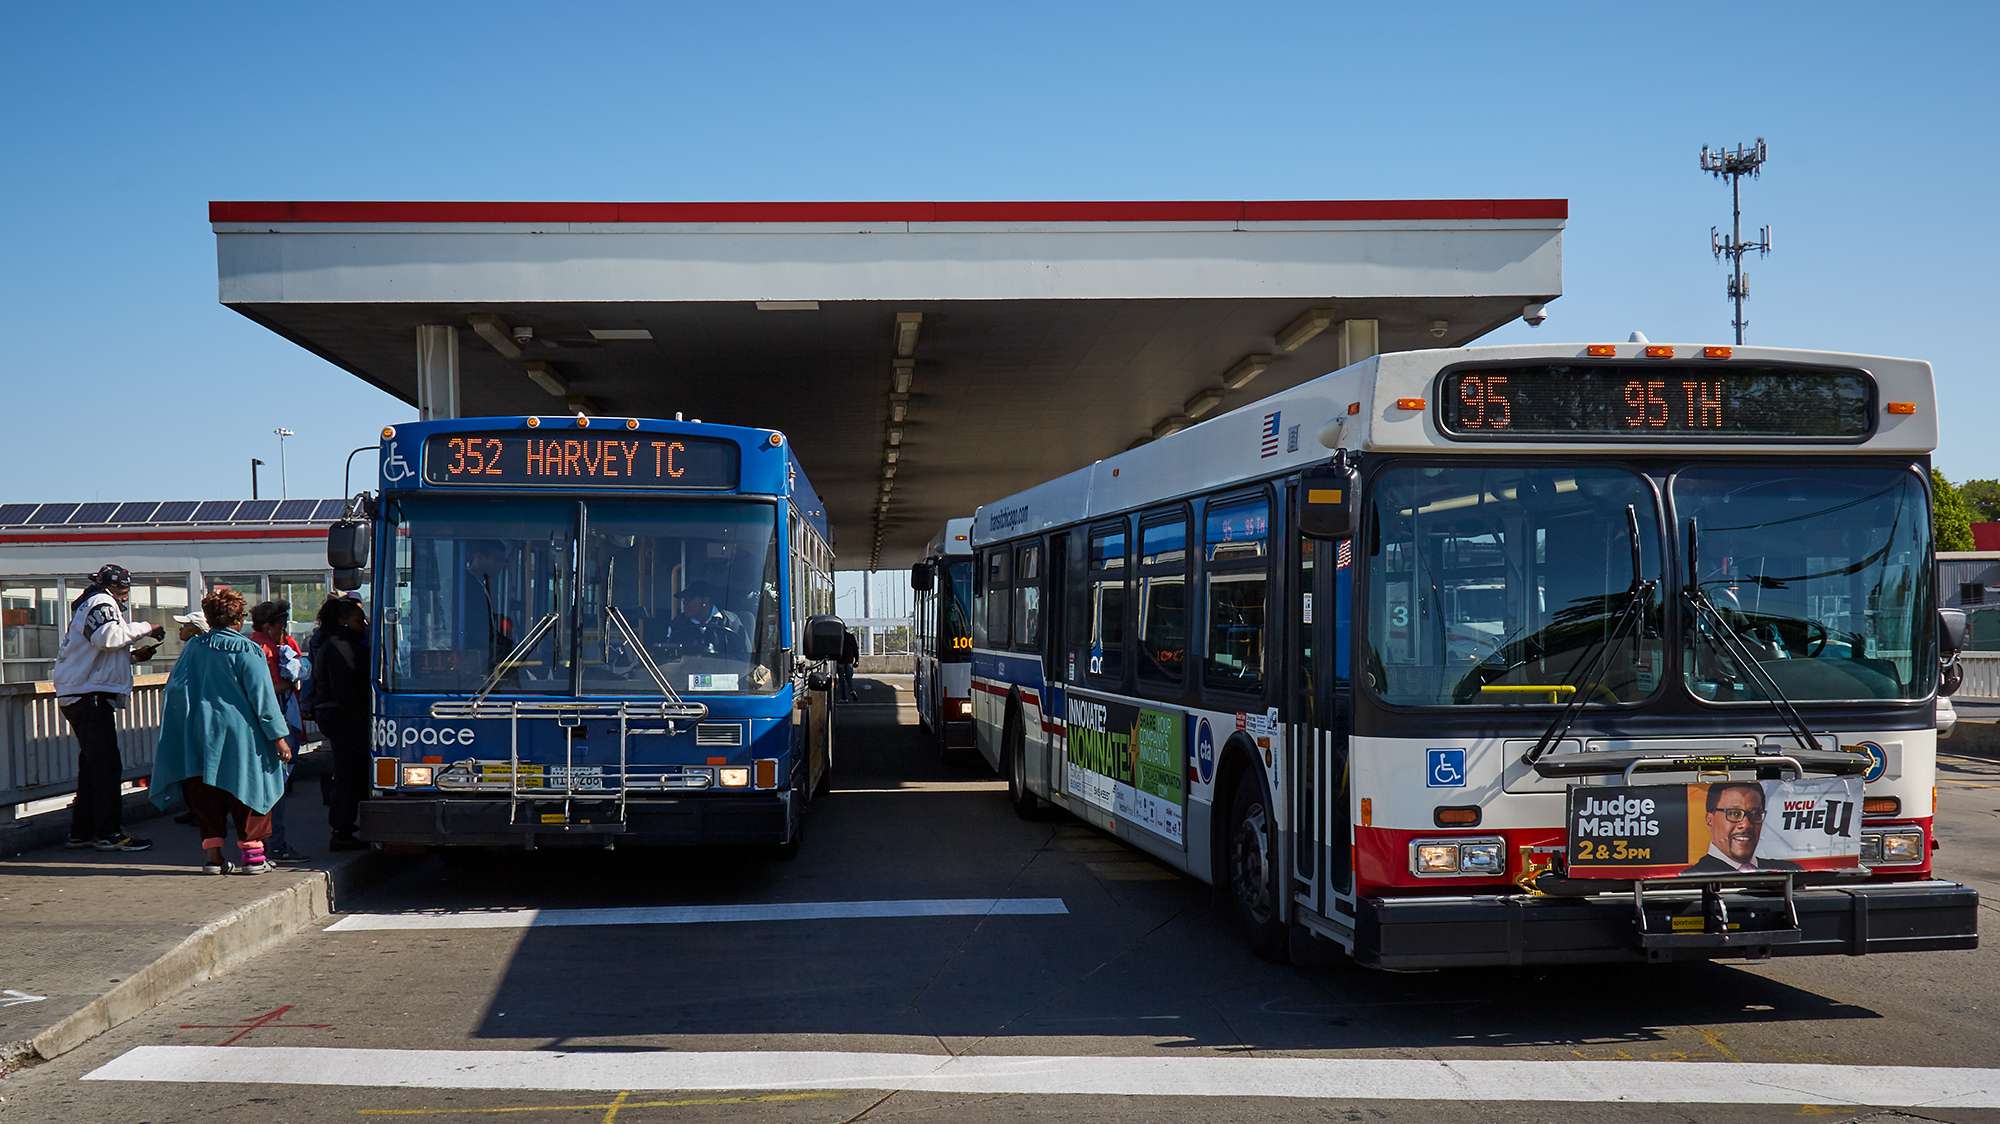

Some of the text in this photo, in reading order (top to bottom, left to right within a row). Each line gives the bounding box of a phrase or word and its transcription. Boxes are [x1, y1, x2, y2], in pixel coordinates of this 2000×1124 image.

[1460, 376, 1722, 429] 95 95 TH
[448, 438, 685, 478] 352 HARVEY TC
[1392, 606, 1409, 627] 3
[1068, 697, 1107, 734] INNOVATE?
[402, 727, 475, 748] pace
[1200, 740, 1212, 761] cta
[1579, 795, 1655, 822] Judge
[1784, 800, 1814, 811] WCIU
[1578, 816, 1660, 837] Mathis
[1782, 811, 1825, 831] THE
[1578, 840, 1650, 860] 2 & 3PM
